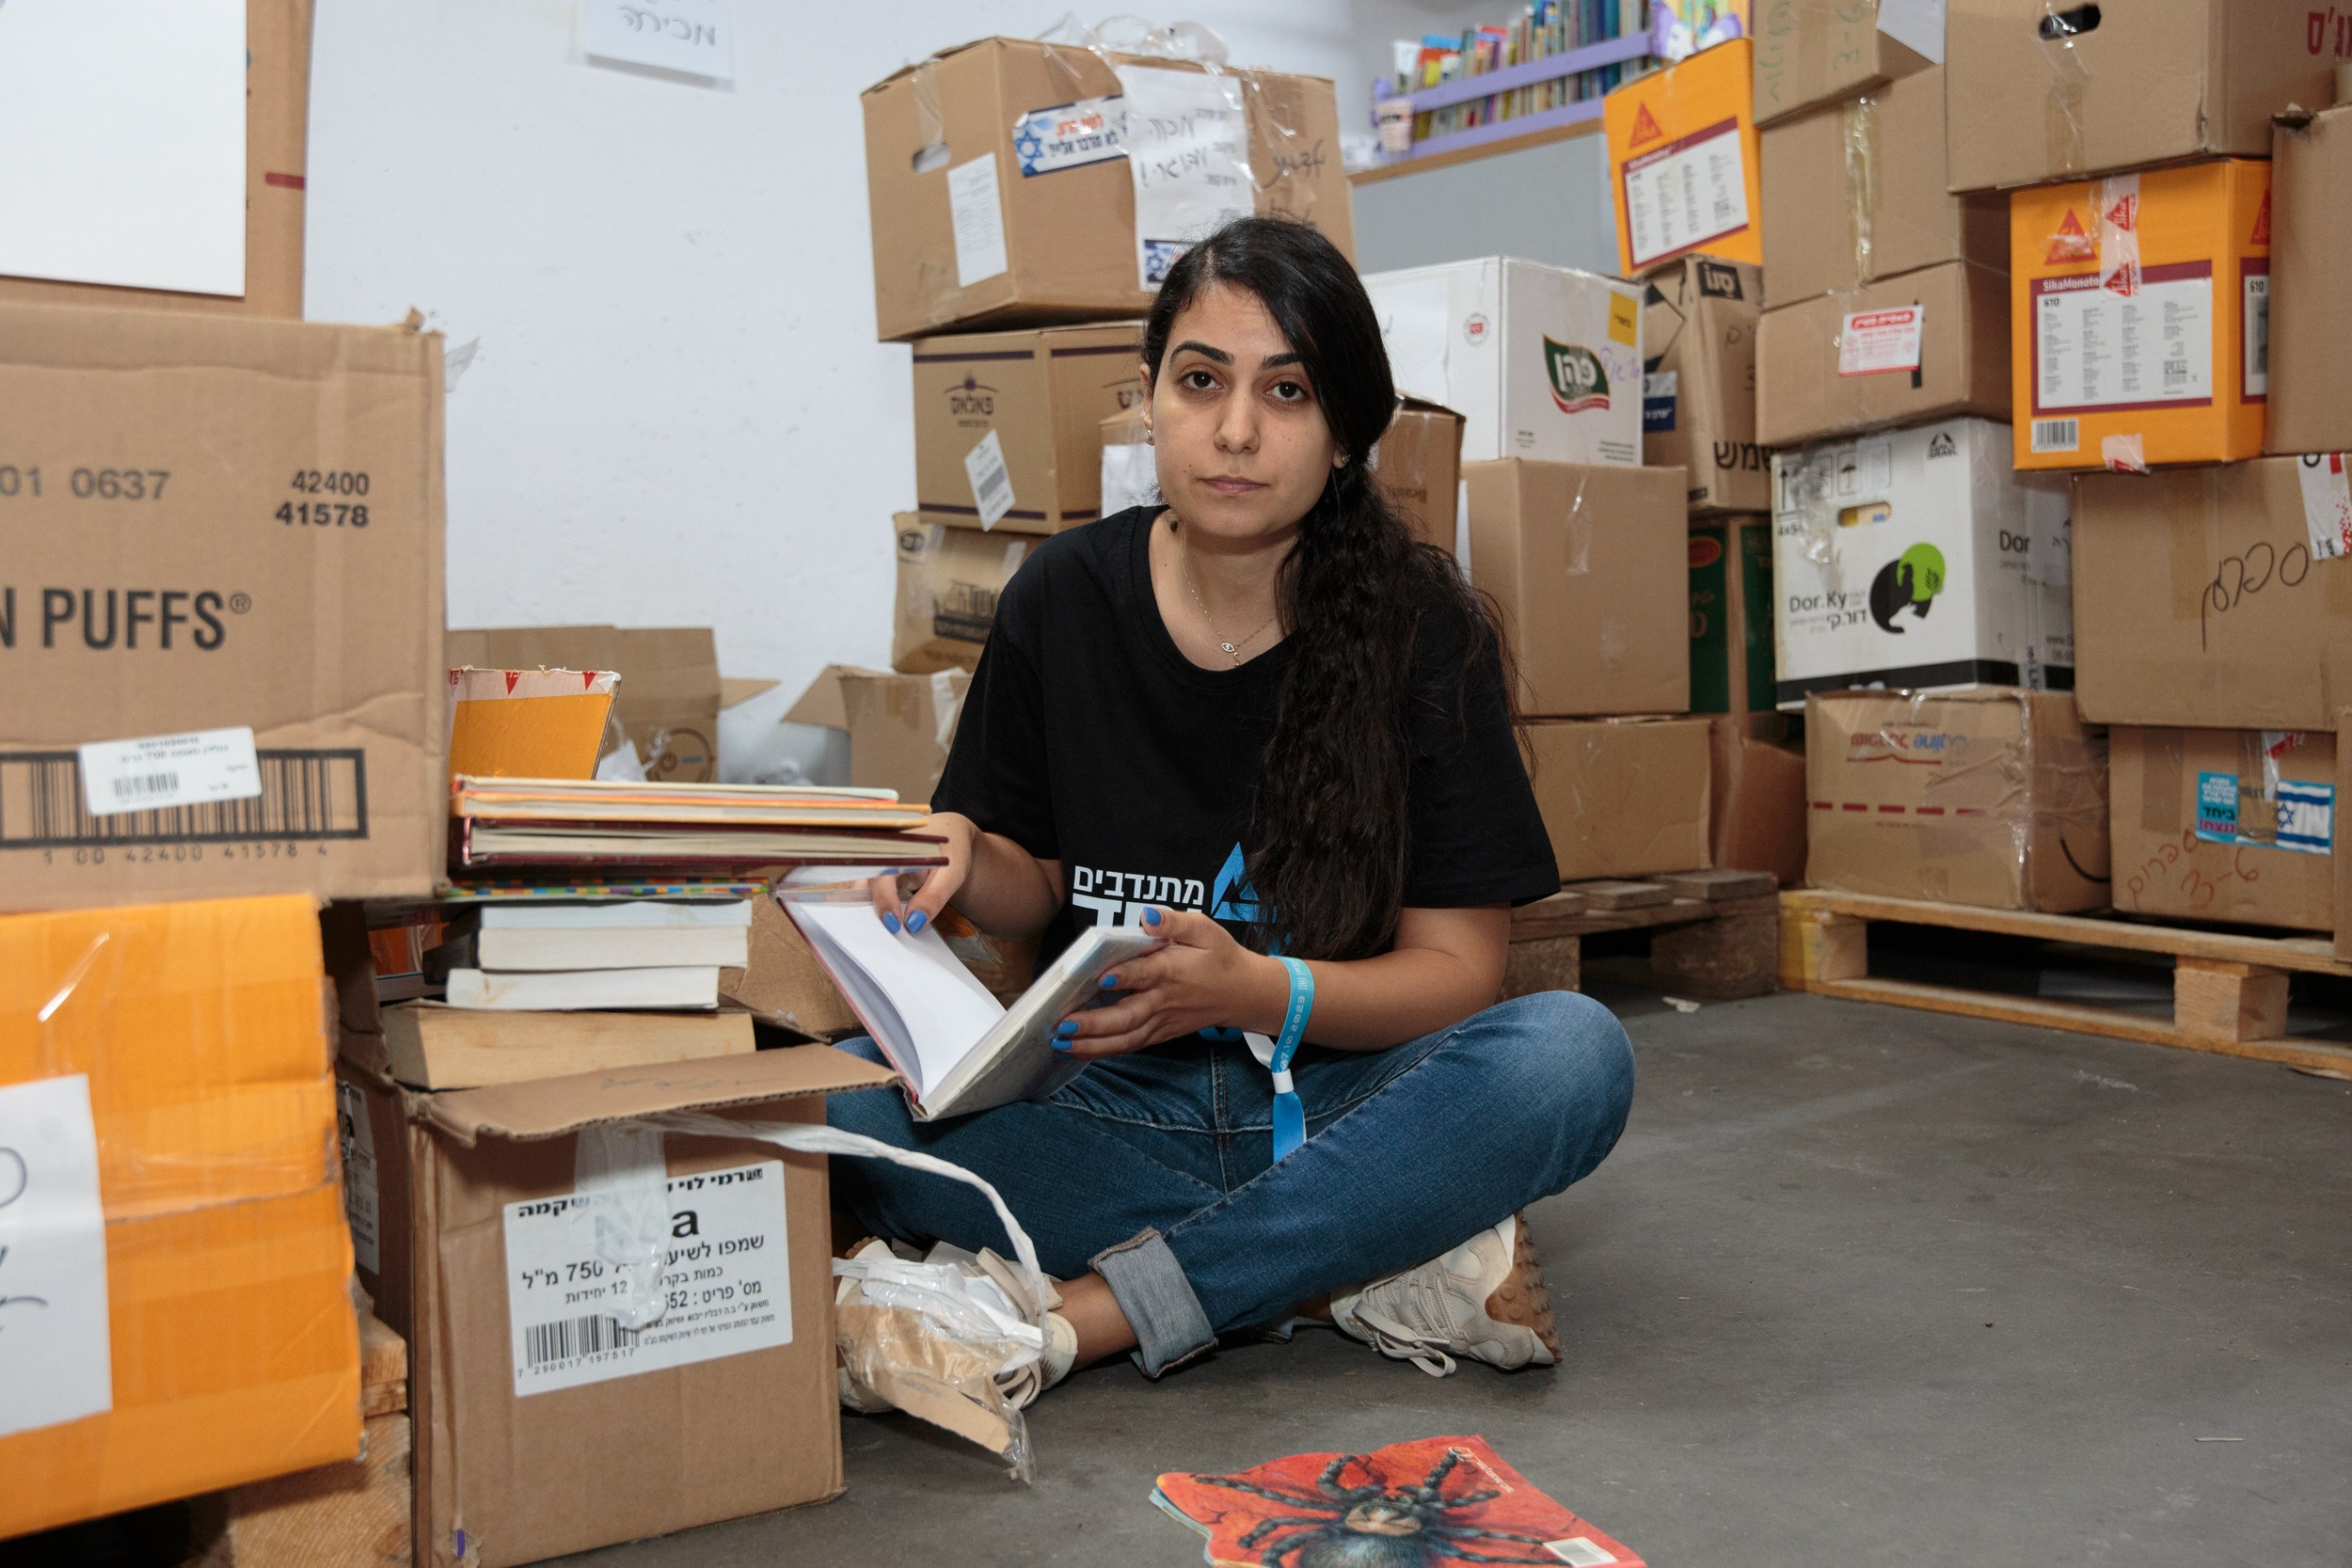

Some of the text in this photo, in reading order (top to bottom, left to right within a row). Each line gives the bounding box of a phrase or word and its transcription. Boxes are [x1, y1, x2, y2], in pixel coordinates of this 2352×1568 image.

[2042, 277, 2100, 293] SikaMonoto
[71, 468, 172, 501] 0637
[291, 469, 371, 497] 42400
[275, 501, 371, 529] 41578
[2202, 806, 2236, 821] ביחד
[1073, 865, 1204, 906] מתנדבים
[1280, 995, 1306, 1070] 07.10.2023
[677, 1169, 748, 1193] רמי לוי
[663, 1241, 712, 1267] לשיע
[718, 1234, 765, 1256] שמפו
[522, 1268, 559, 1291] מ"ל
[694, 1265, 723, 1282] כמות
[565, 1287, 607, 1306] יחידות
[612, 1279, 628, 1296] 12
[702, 1284, 736, 1305] פריט
[738, 1279, 763, 1296] מס'
[533, 1357, 582, 1375] 290017
[589, 1347, 635, 1365] 197517
